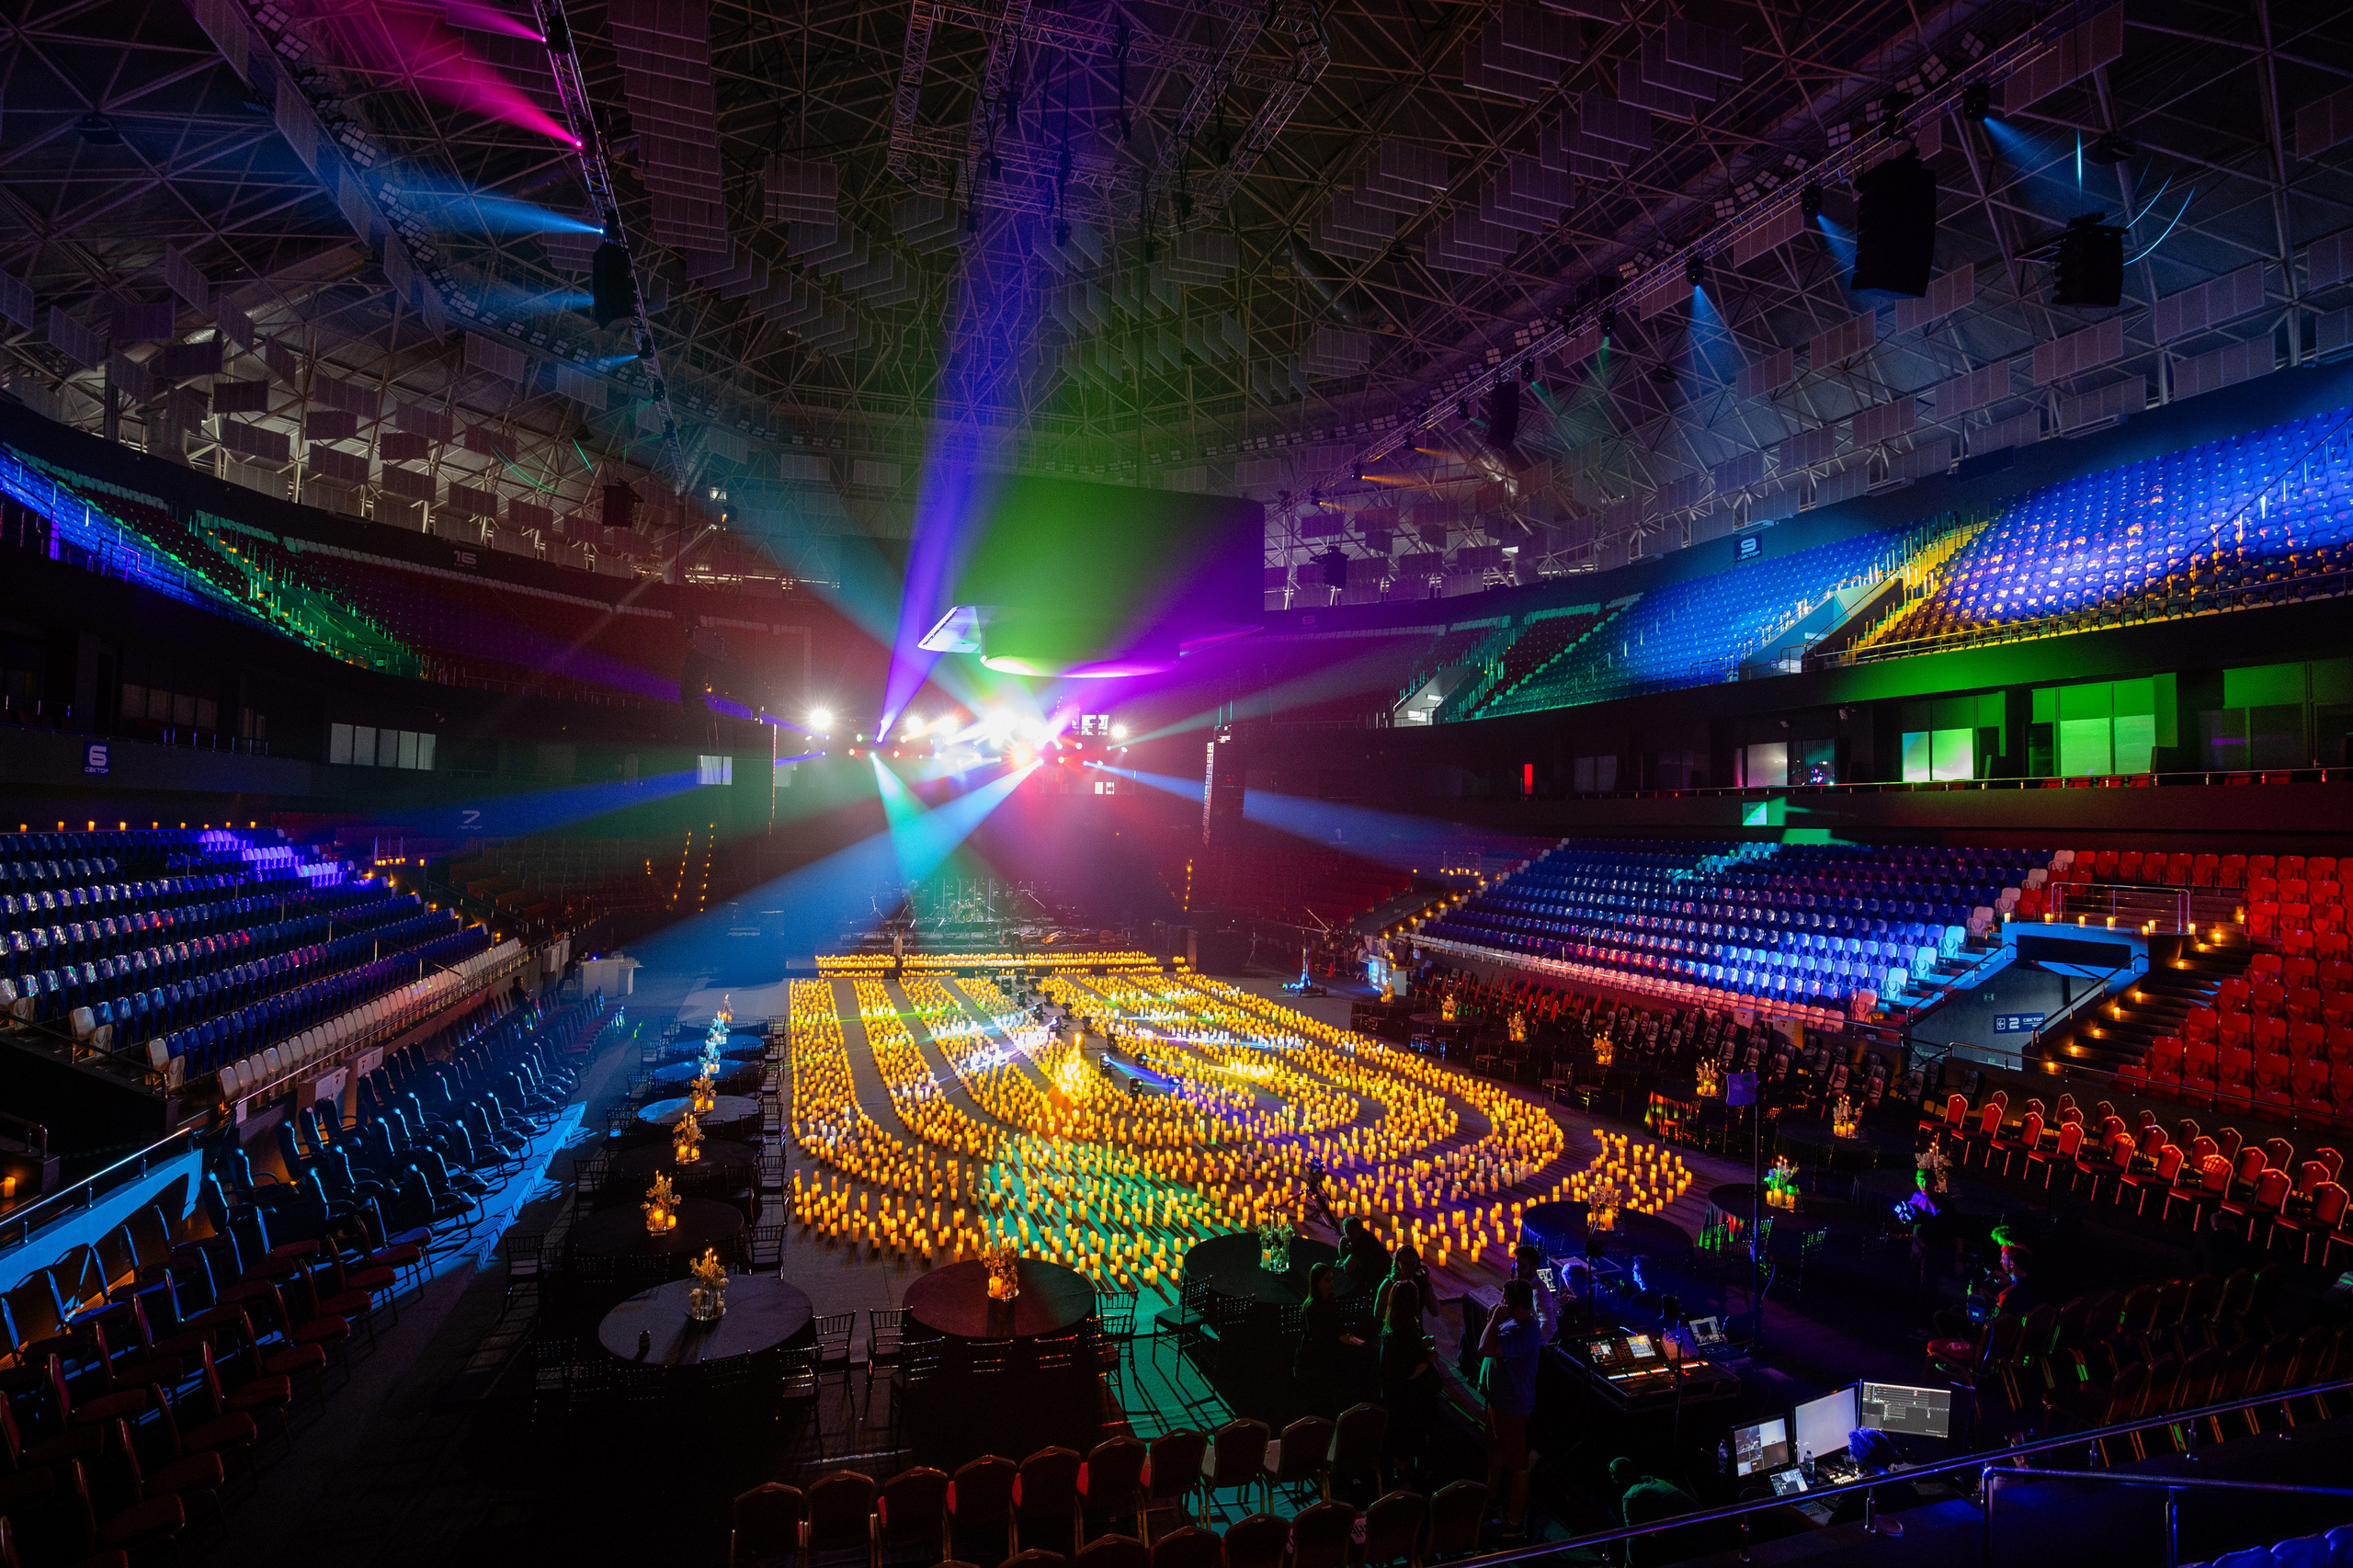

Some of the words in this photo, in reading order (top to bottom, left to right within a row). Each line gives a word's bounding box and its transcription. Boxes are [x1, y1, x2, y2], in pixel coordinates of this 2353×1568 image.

[1741, 538, 1756, 553] 9
[453, 550, 477, 565] 16
[89, 744, 107, 767] 6
[461, 810, 481, 824] 7
[2008, 1017, 2019, 1029] 2
